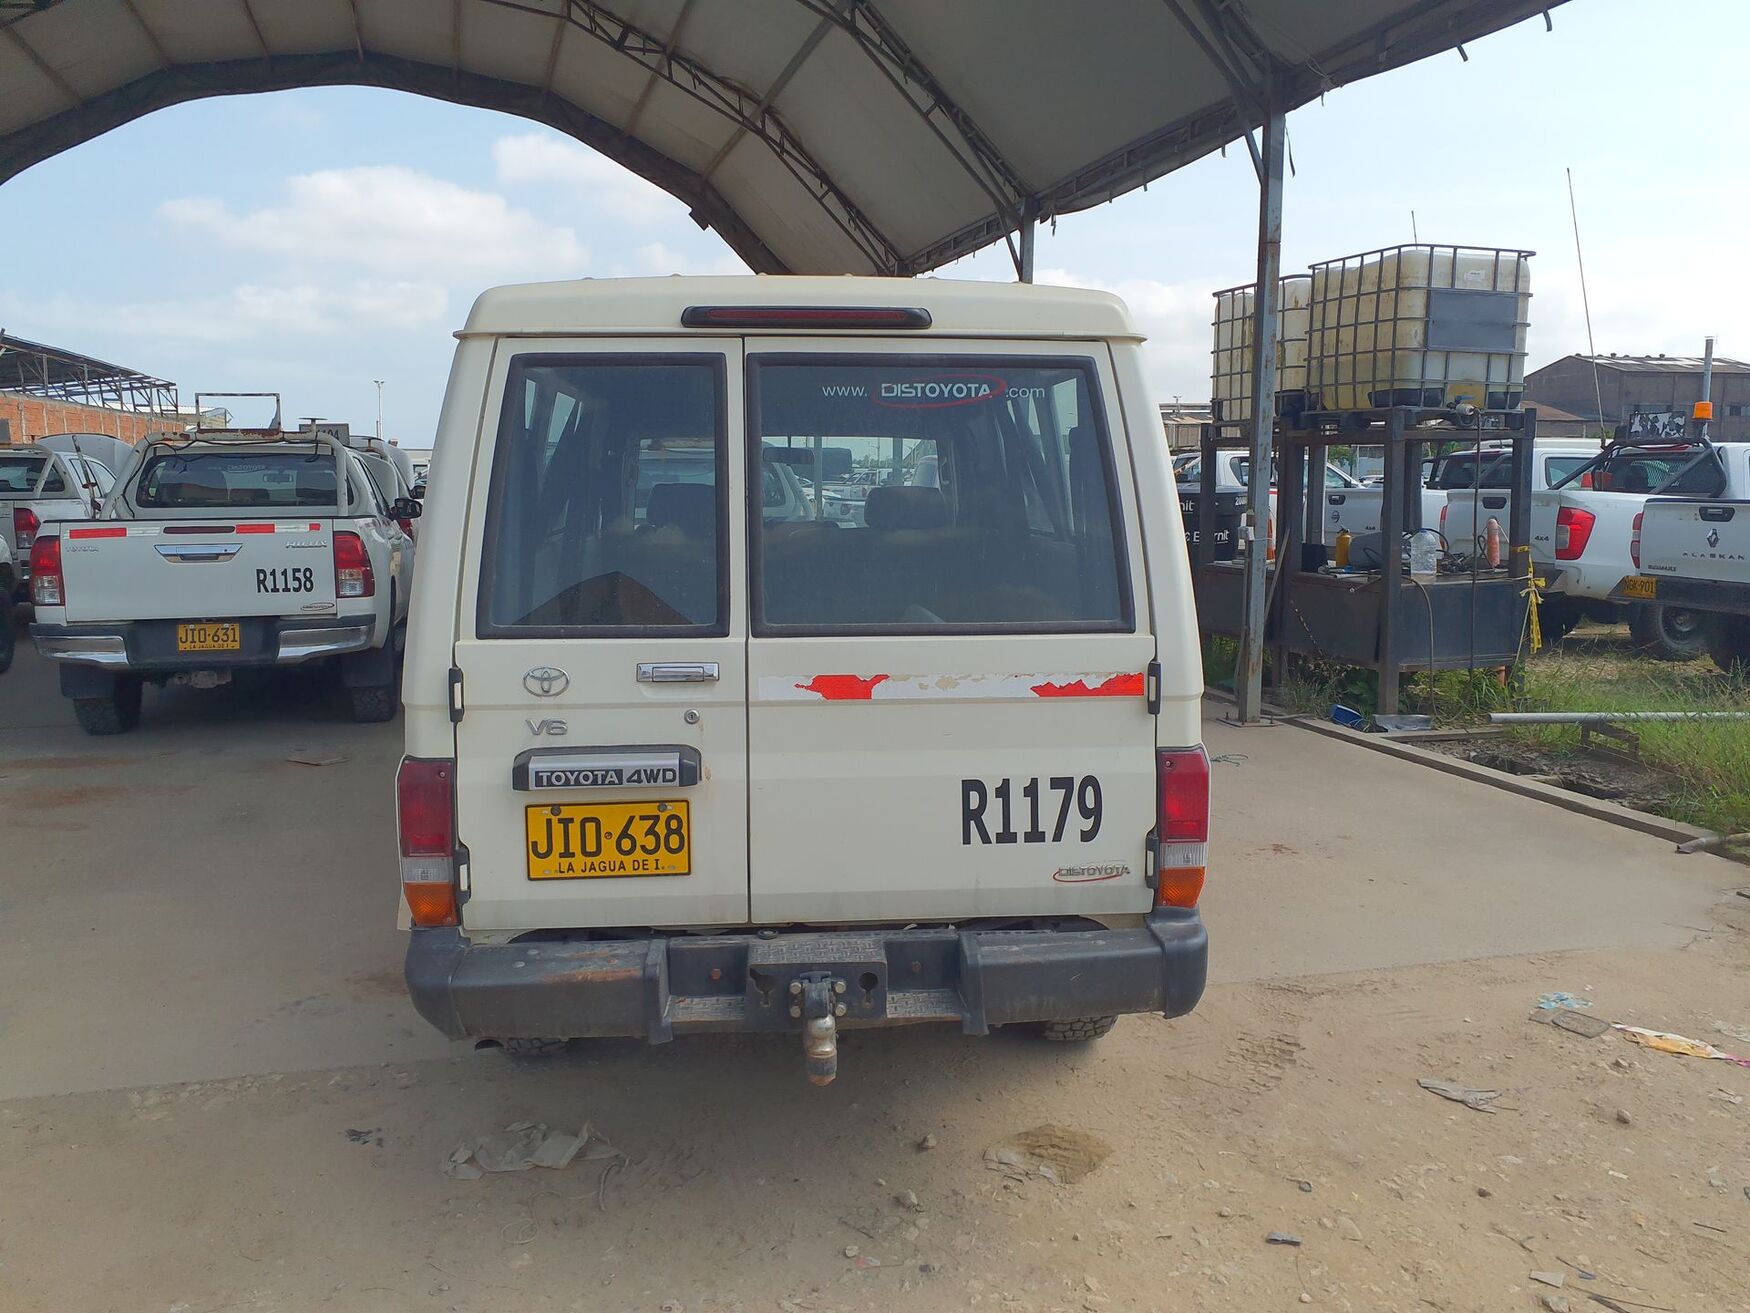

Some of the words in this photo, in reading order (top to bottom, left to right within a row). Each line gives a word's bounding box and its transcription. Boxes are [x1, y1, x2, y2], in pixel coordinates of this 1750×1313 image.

[822, 386, 868, 397] www.
[881, 382, 993, 398] DISTOYOTA
[1682, 552, 1745, 560] ALASKAN
[256, 567, 314, 593] R1158
[525, 718, 568, 736] V6
[538, 769, 622, 787] TOYOTA
[626, 768, 677, 785] 4WD
[961, 775, 1103, 845] R1179
[558, 861, 575, 874] LA
[581, 860, 626, 873] JAGUA
[632, 859, 650, 871] DE
